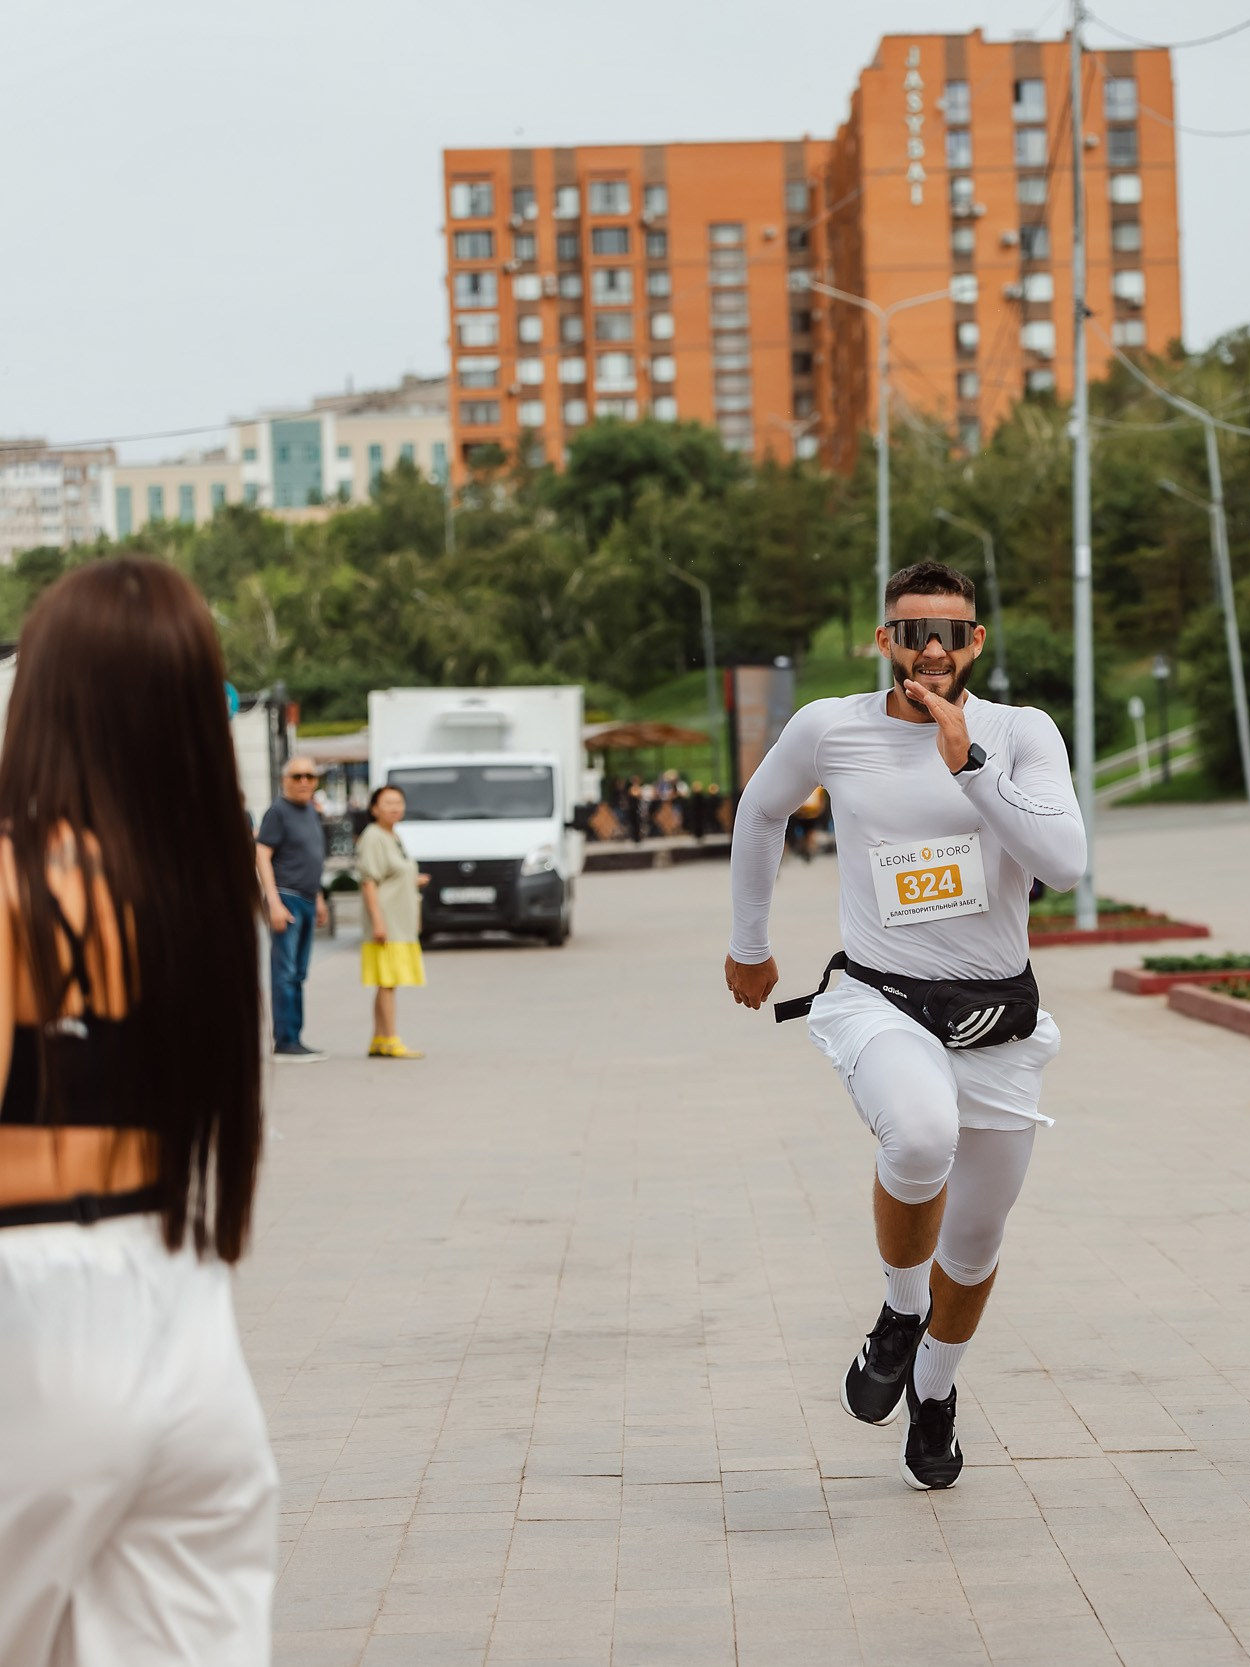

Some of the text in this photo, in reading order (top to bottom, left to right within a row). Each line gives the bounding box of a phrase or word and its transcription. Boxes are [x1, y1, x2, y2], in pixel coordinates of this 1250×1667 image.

[904, 44, 926, 205] JASYBAI
[880, 844, 970, 867] LEONE D'ORO
[904, 870, 956, 900] 324
[890, 898, 977, 918] БЛАГОТВОРИТЕЛЬНЫЙ ЗАБЕГ
